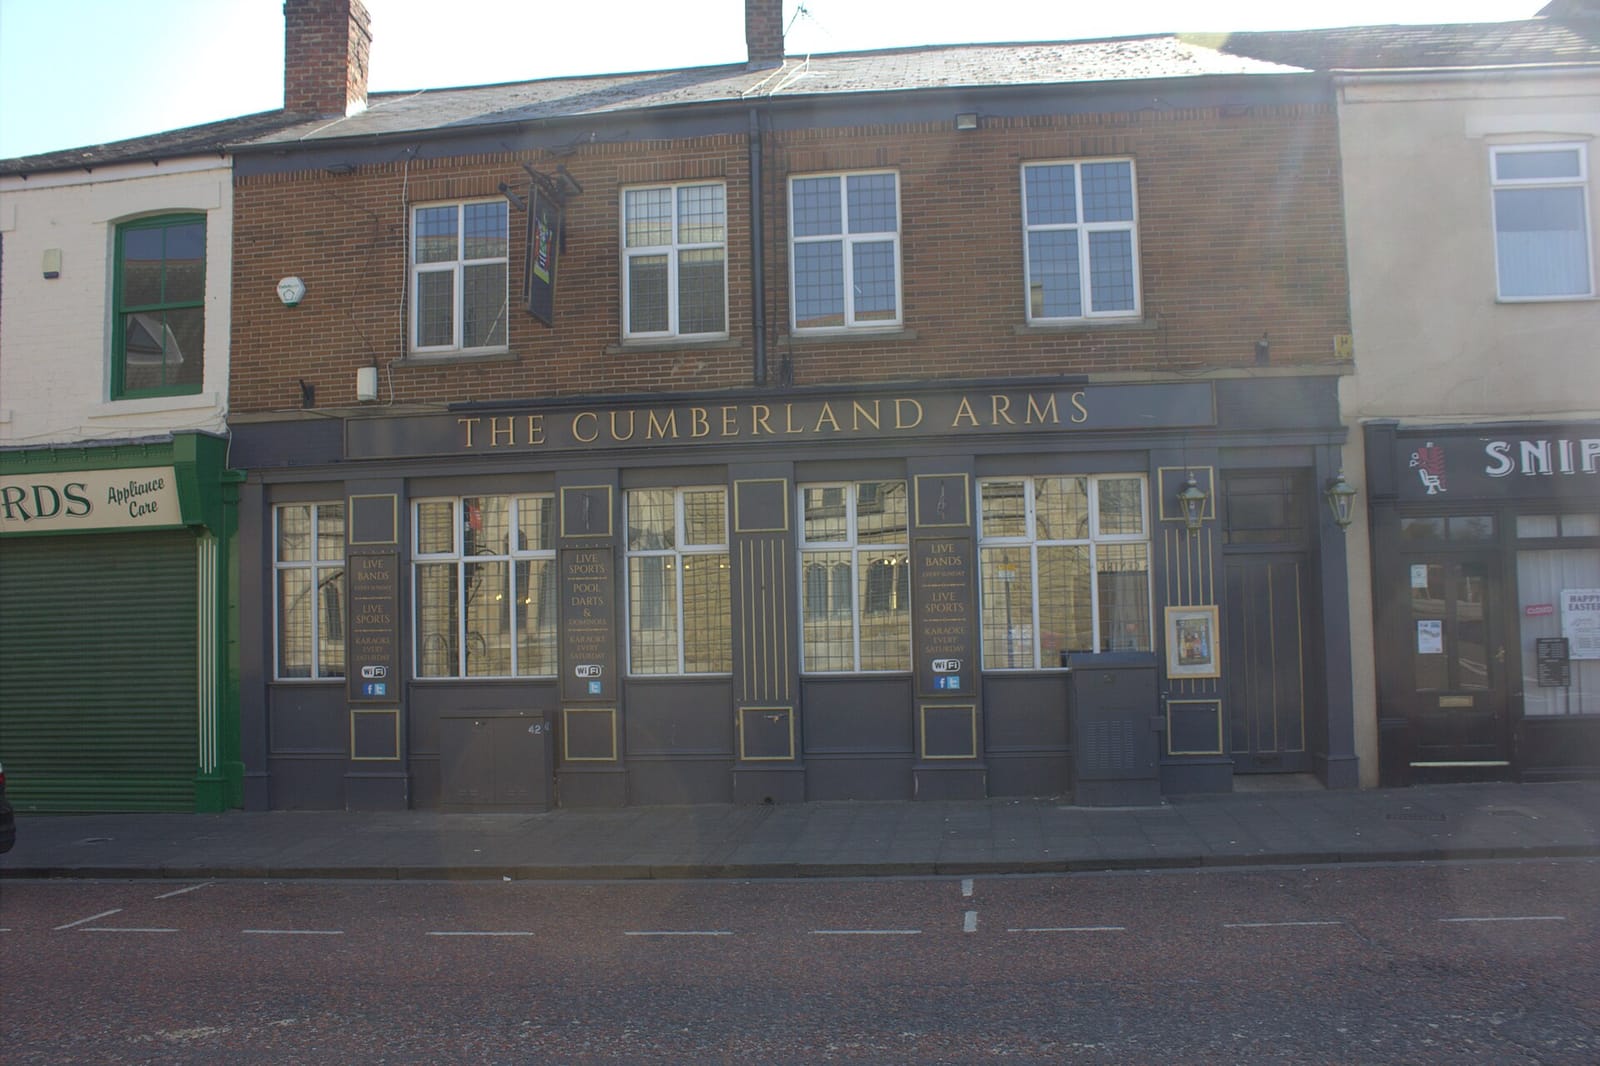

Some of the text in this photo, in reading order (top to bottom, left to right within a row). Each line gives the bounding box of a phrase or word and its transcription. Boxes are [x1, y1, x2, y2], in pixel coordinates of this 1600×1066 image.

[457, 391, 1088, 448] THE CUMBERLAND ARMS
[1485, 439, 1600, 478] SNIP
[108, 478, 165, 505] Appliance
[1, 483, 93, 522] RDS
[129, 500, 158, 519] Care
[931, 544, 955, 553] LIVE
[576, 553, 598, 563] LIVE
[925, 557, 962, 567] BANDS
[363, 560, 384, 569] LIVE
[569, 564, 605, 573] SPORTS
[357, 571, 389, 582] BANDS
[573, 583, 600, 593] POOL
[571, 596, 603, 606] DARTS
[933, 592, 955, 601] LIVE
[363, 604, 384, 613] LIVE
[583, 608, 591, 617] &
[926, 603, 964, 613] SPORTS
[356, 615, 390, 624] SPORTS
[528, 724, 542, 735] 42
